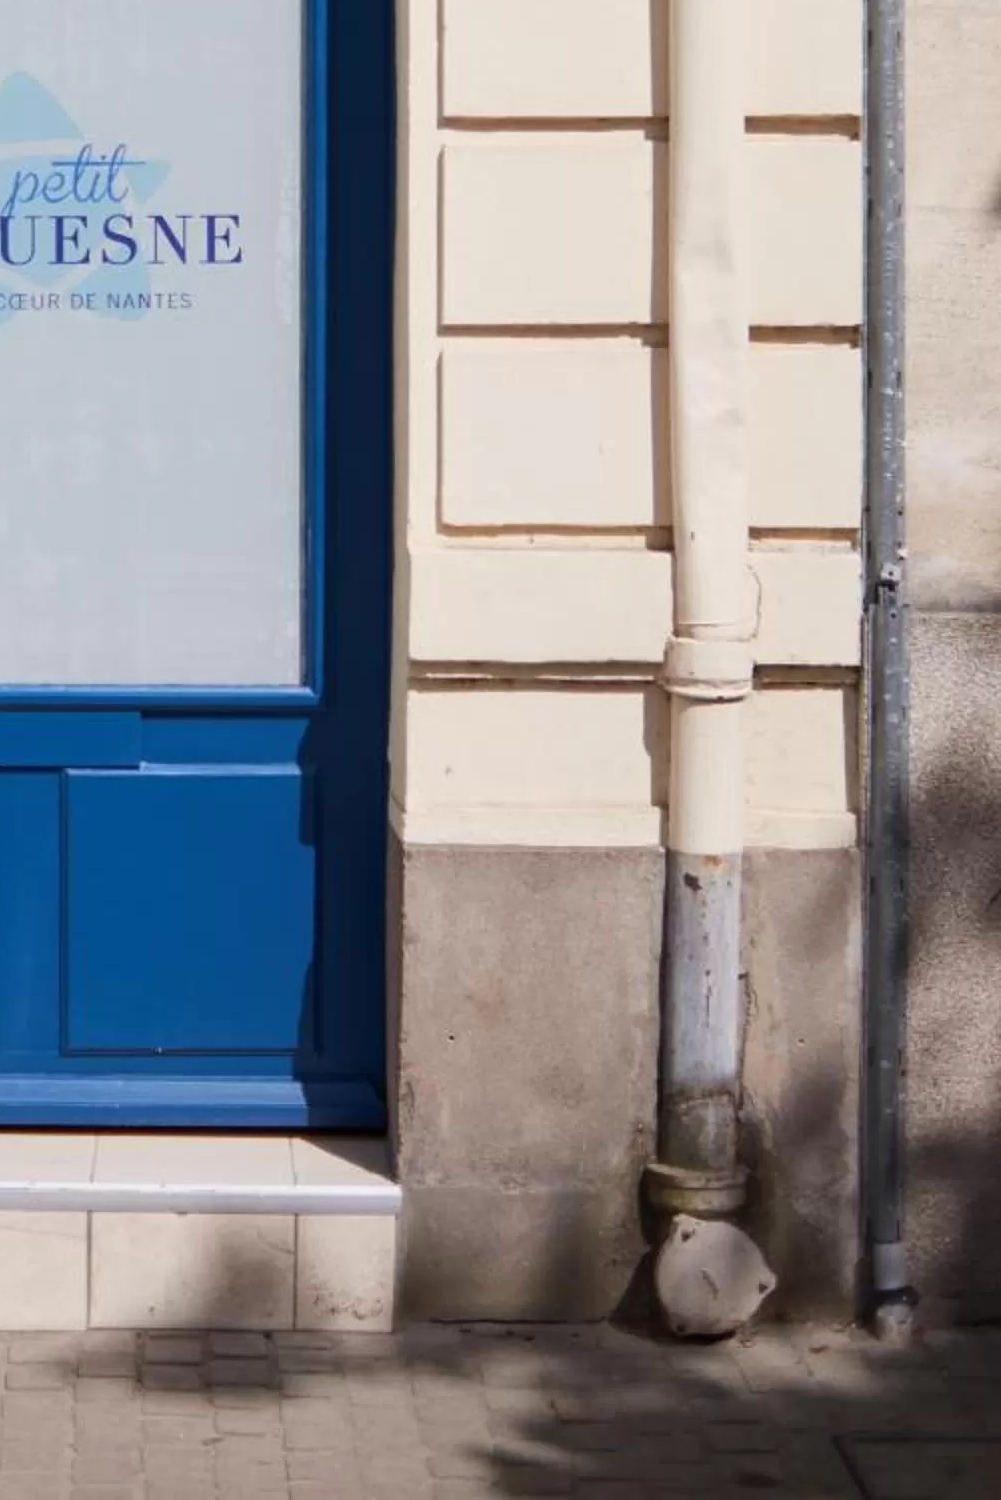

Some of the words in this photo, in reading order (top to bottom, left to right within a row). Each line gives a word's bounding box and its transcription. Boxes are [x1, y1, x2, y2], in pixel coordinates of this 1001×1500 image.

[0, 143, 147, 222] petit
[70, 293, 97, 311] DE
[105, 292, 194, 310] NANTES
